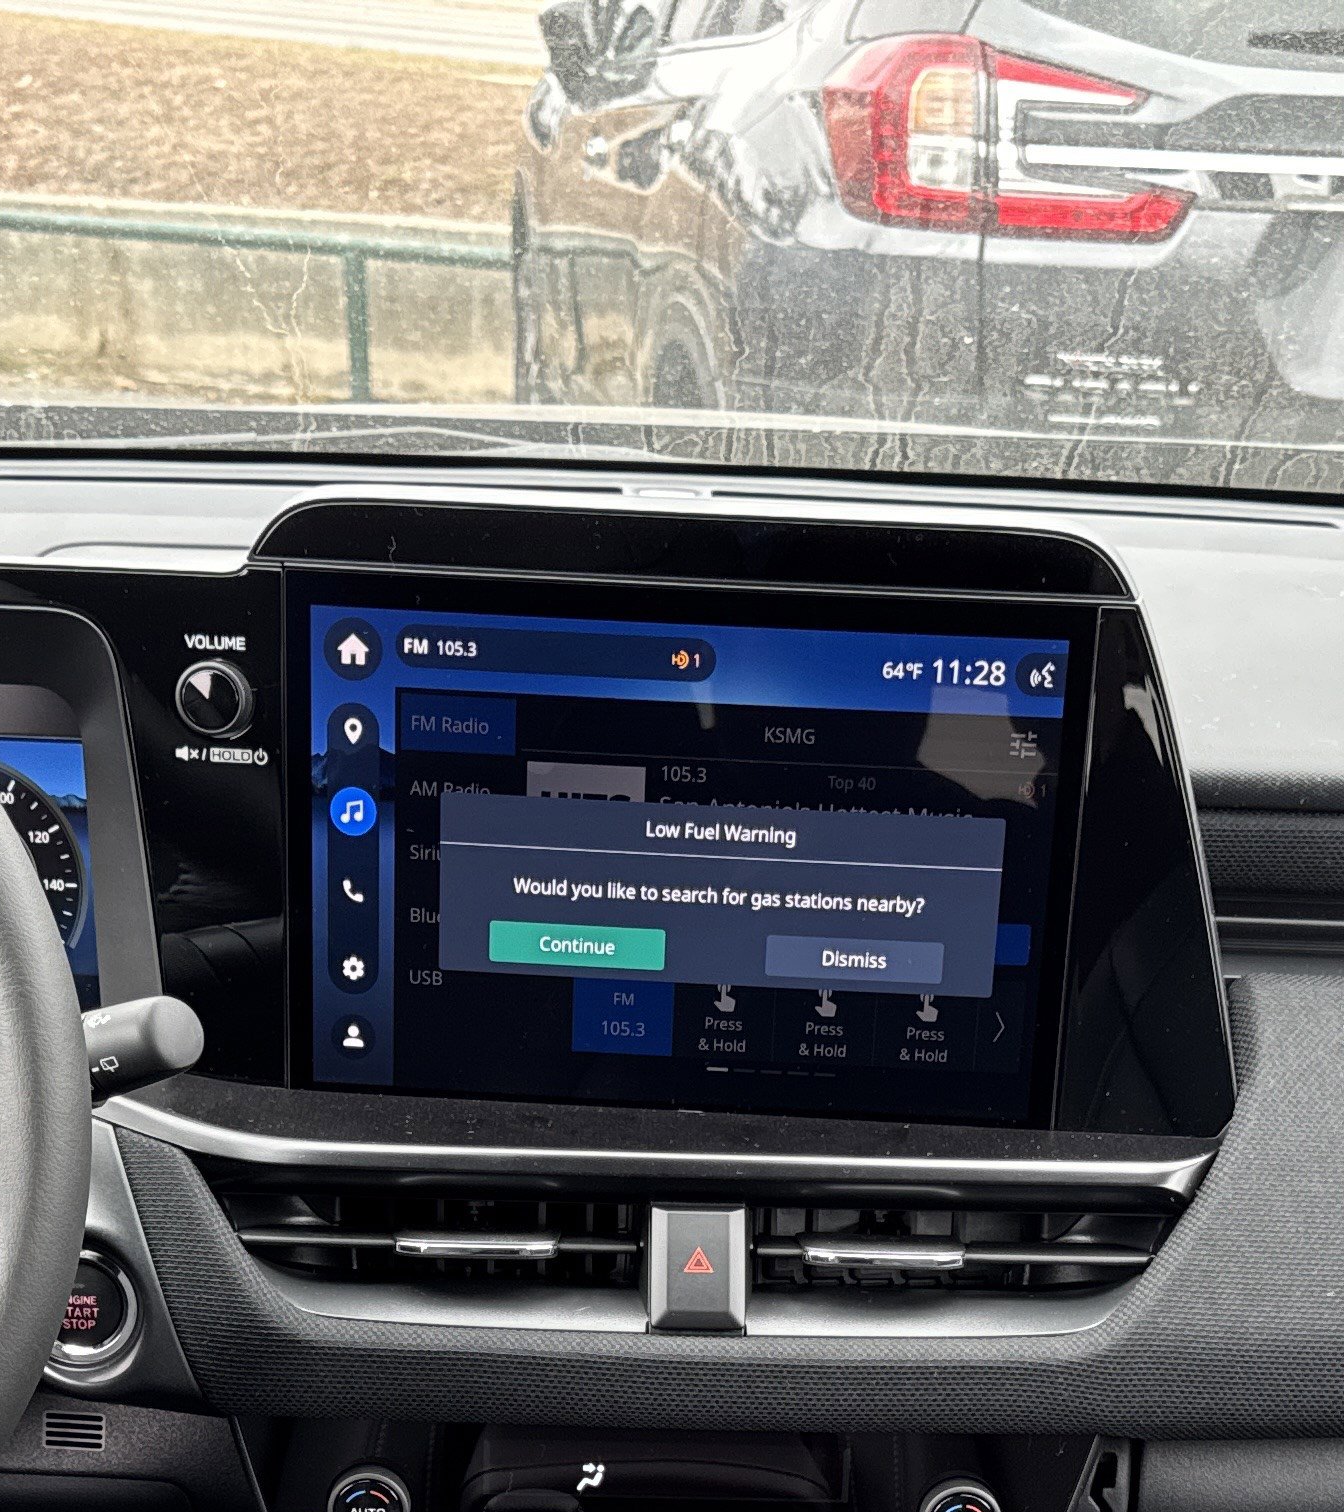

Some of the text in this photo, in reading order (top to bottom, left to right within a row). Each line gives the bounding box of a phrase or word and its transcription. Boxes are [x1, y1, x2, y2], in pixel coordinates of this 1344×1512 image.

[183, 633, 247, 651] VOLUME
[403, 637, 477, 657] FM 105.3
[881, 658, 1006, 686] 64°F 11:28
[410, 714, 489, 735] FM Radio
[764, 727, 816, 745] KSMG
[211, 749, 252, 762] HOLD
[661, 764, 707, 783] 105.3
[409, 780, 438, 797] AM
[828, 776, 877, 793] Top 40
[28, 830, 50, 844] 120
[645, 820, 797, 849] Low Fuel Warning
[43, 878, 65, 892] 140
[513, 877, 925, 918] Would you like to search for gas stations nearby?
[539, 935, 616, 956] Continue
[821, 949, 888, 970] Dismiss
[408, 970, 444, 987] USB
[612, 991, 635, 1007] FM
[601, 1020, 646, 1038] 105.3
[704, 1016, 743, 1032] Press
[805, 1021, 844, 1037] Press
[906, 1026, 945, 1042] Press
[698, 1038, 747, 1054] & Hold
[798, 1043, 847, 1058] & Hold
[899, 1048, 948, 1063] & Hold
[62, 1318, 96, 1330] STOP
